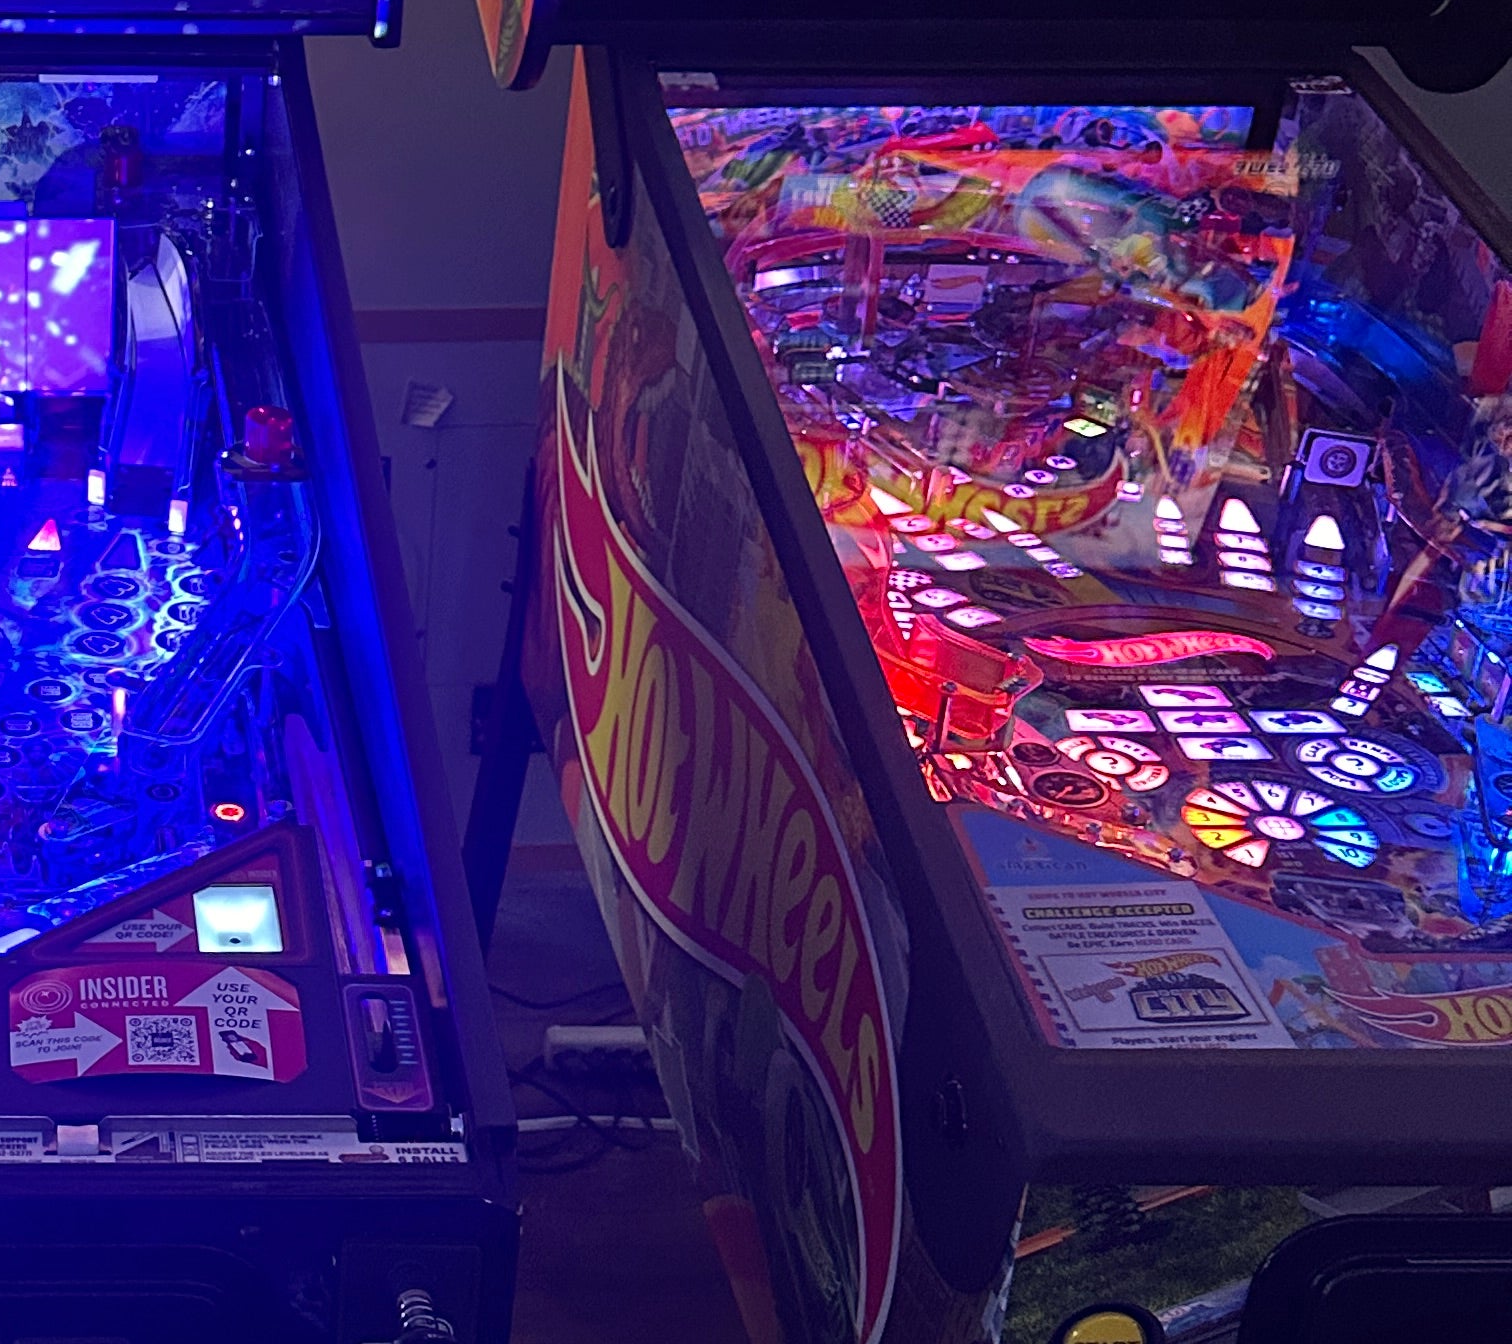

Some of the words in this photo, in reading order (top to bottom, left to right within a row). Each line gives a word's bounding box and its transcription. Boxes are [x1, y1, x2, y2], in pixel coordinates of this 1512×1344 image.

[1096, 641, 1162, 663] HOT
[586, 539, 690, 865] HOT
[668, 654, 881, 1155] WHEELS
[1025, 906, 1113, 918] CHALLENGE
[1115, 904, 1192, 916] ACCEPTED
[150, 923, 183, 931] YOUR
[115, 931, 132, 939] QR
[136, 931, 174, 939] CODE!
[79, 975, 168, 1001] INSIDER
[216, 982, 251, 993] USE
[80, 1000, 170, 1010] CONNECTED
[212, 993, 258, 1005] YOUR
[1131, 987, 1246, 1018] CITY
[224, 1006, 248, 1018] QR
[214, 1017, 262, 1029] CODE
[15, 1039, 43, 1049] SCAN
[73, 1035, 102, 1043] CODE
[395, 1147, 459, 1155] INSTALL
